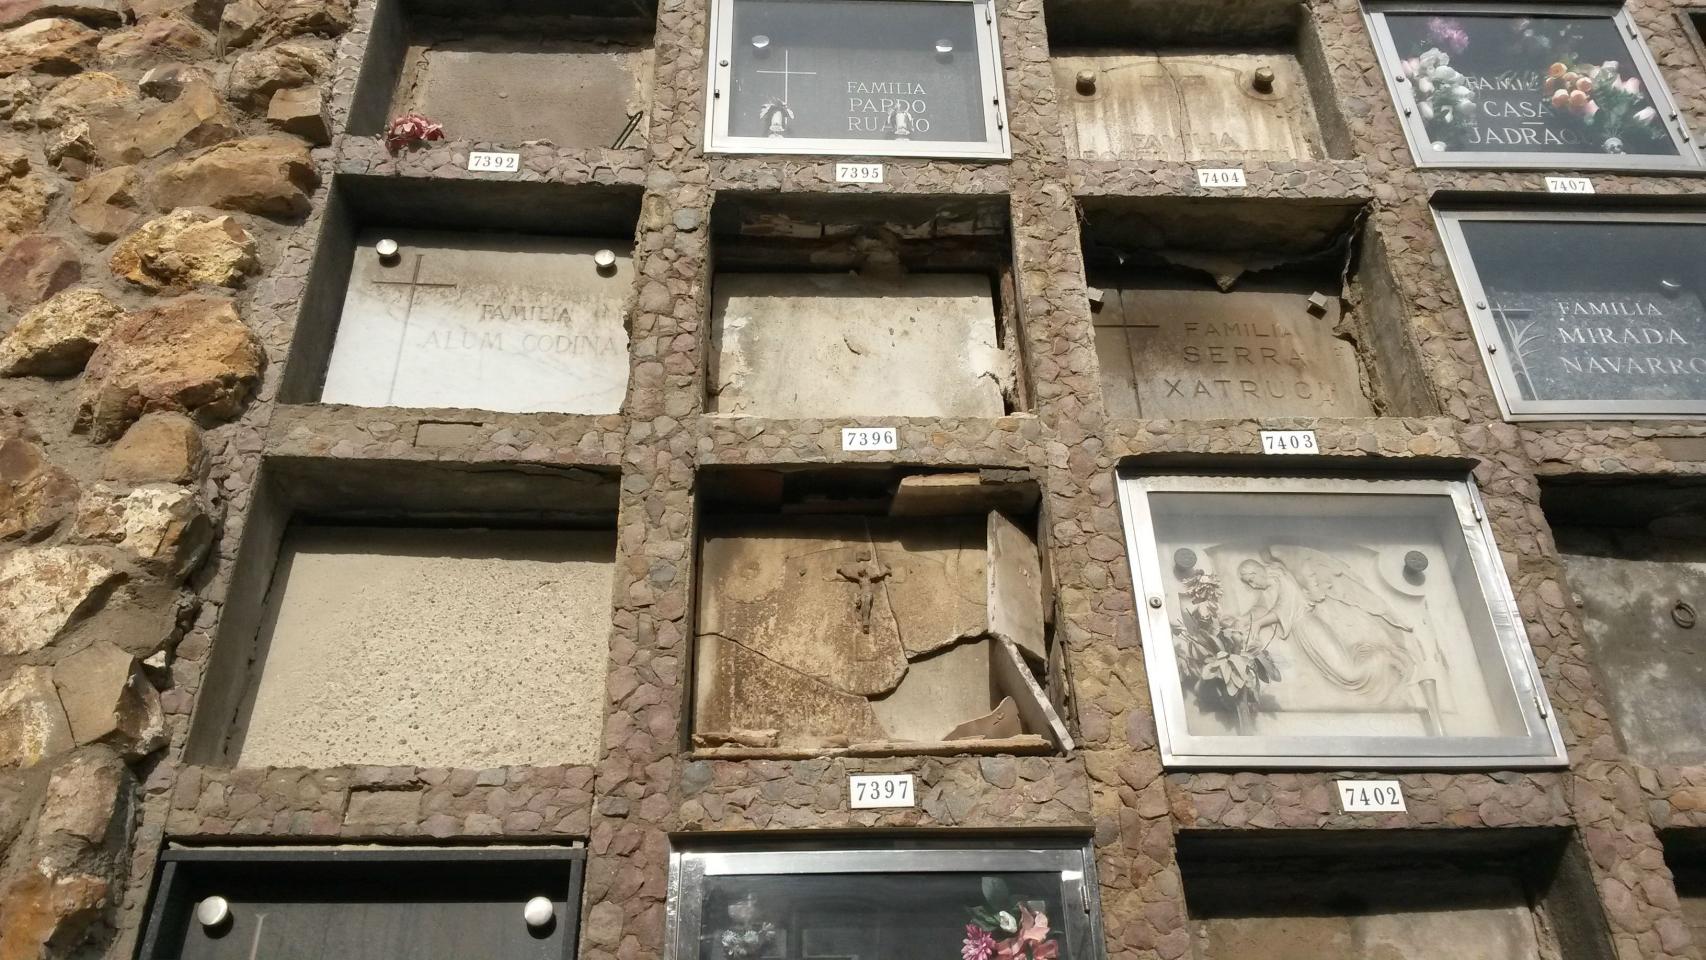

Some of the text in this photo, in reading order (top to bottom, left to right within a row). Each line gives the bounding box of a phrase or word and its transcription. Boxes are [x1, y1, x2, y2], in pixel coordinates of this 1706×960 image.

[847, 81, 927, 95] FAMILIA
[473, 155, 516, 169] 7392
[840, 166, 880, 179] 7395
[1202, 171, 1240, 184] 7404
[1550, 180, 1587, 192] 7407
[479, 303, 573, 323] FAMILIA
[1557, 301, 1663, 316] FAMILIA
[1184, 322, 1292, 337] FAMILIA
[1557, 326, 1688, 345] MIRADA
[522, 333, 619, 356] CODINA
[1183, 345, 1307, 367] SERRA
[847, 430, 893, 446] 7396
[1265, 434, 1314, 450] 7403
[856, 779, 909, 801] 7397
[1345, 786, 1400, 806] 7402
